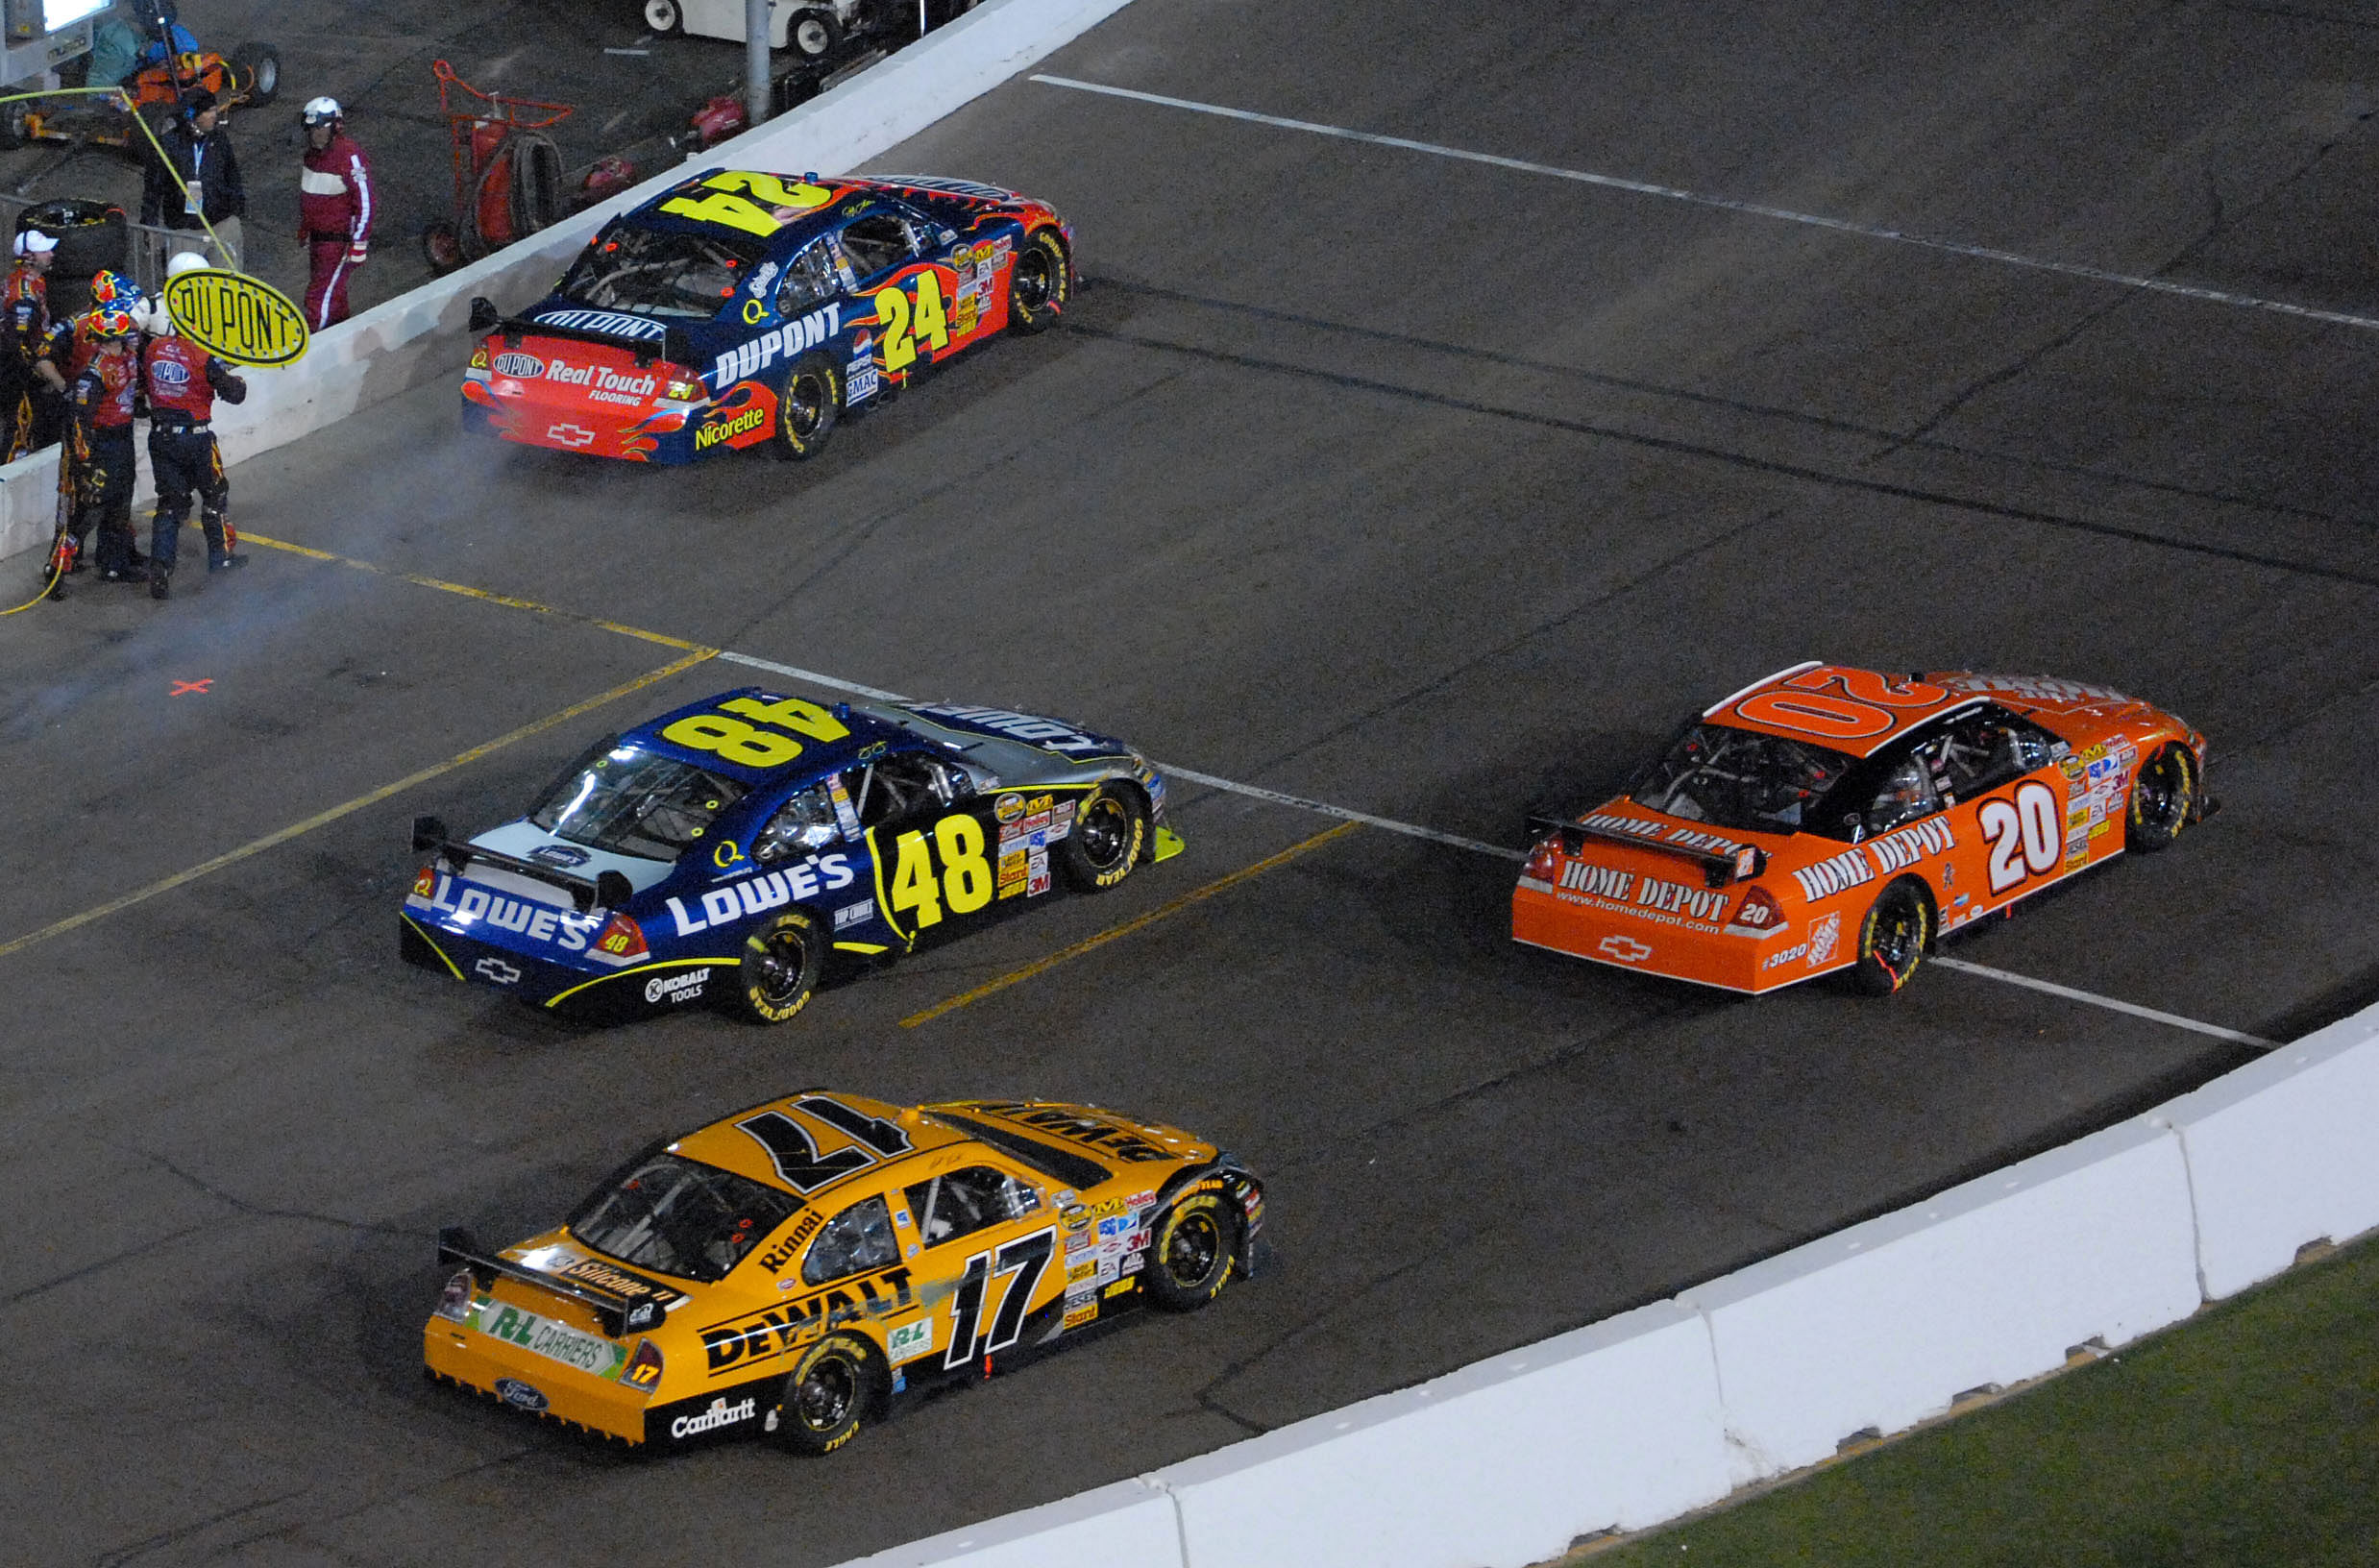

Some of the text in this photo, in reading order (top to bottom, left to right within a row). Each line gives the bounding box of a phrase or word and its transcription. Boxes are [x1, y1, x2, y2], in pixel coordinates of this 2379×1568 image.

[659, 171, 831, 237] 24
[743, 299, 770, 325] Q
[874, 269, 949, 373] 24
[716, 302, 841, 391] DUPONT
[545, 359, 655, 395] Real Touch
[588, 389, 642, 407] FLOORING
[846, 369, 878, 400] GMAC
[696, 406, 764, 451] Nicorette
[1734, 665, 1951, 740] 20
[663, 696, 851, 768] 48
[714, 840, 746, 869] Q
[1791, 816, 1956, 904] HOME DEPOT
[1978, 779, 2062, 897] 20
[892, 814, 993, 929] 48
[1029, 874, 1049, 894] 3M
[1557, 860, 1729, 922] HOME DEPOT
[665, 853, 854, 937] LOWE'S
[1556, 890, 1720, 936] www.homedepot.com
[1740, 903, 1772, 924] 20
[604, 935, 629, 953] 48
[663, 967, 712, 992] KOBALT
[671, 984, 703, 1003] TOOLS
[734, 1095, 917, 1195] 17
[758, 1207, 824, 1276] Rinnai
[1126, 1231, 1150, 1252] 3M
[570, 1261, 652, 1297] Silicone
[943, 1223, 1058, 1371] 17
[699, 1266, 914, 1371] DEWALT
[534, 1325, 605, 1370] CARRIERS
[630, 1363, 660, 1384] 17
